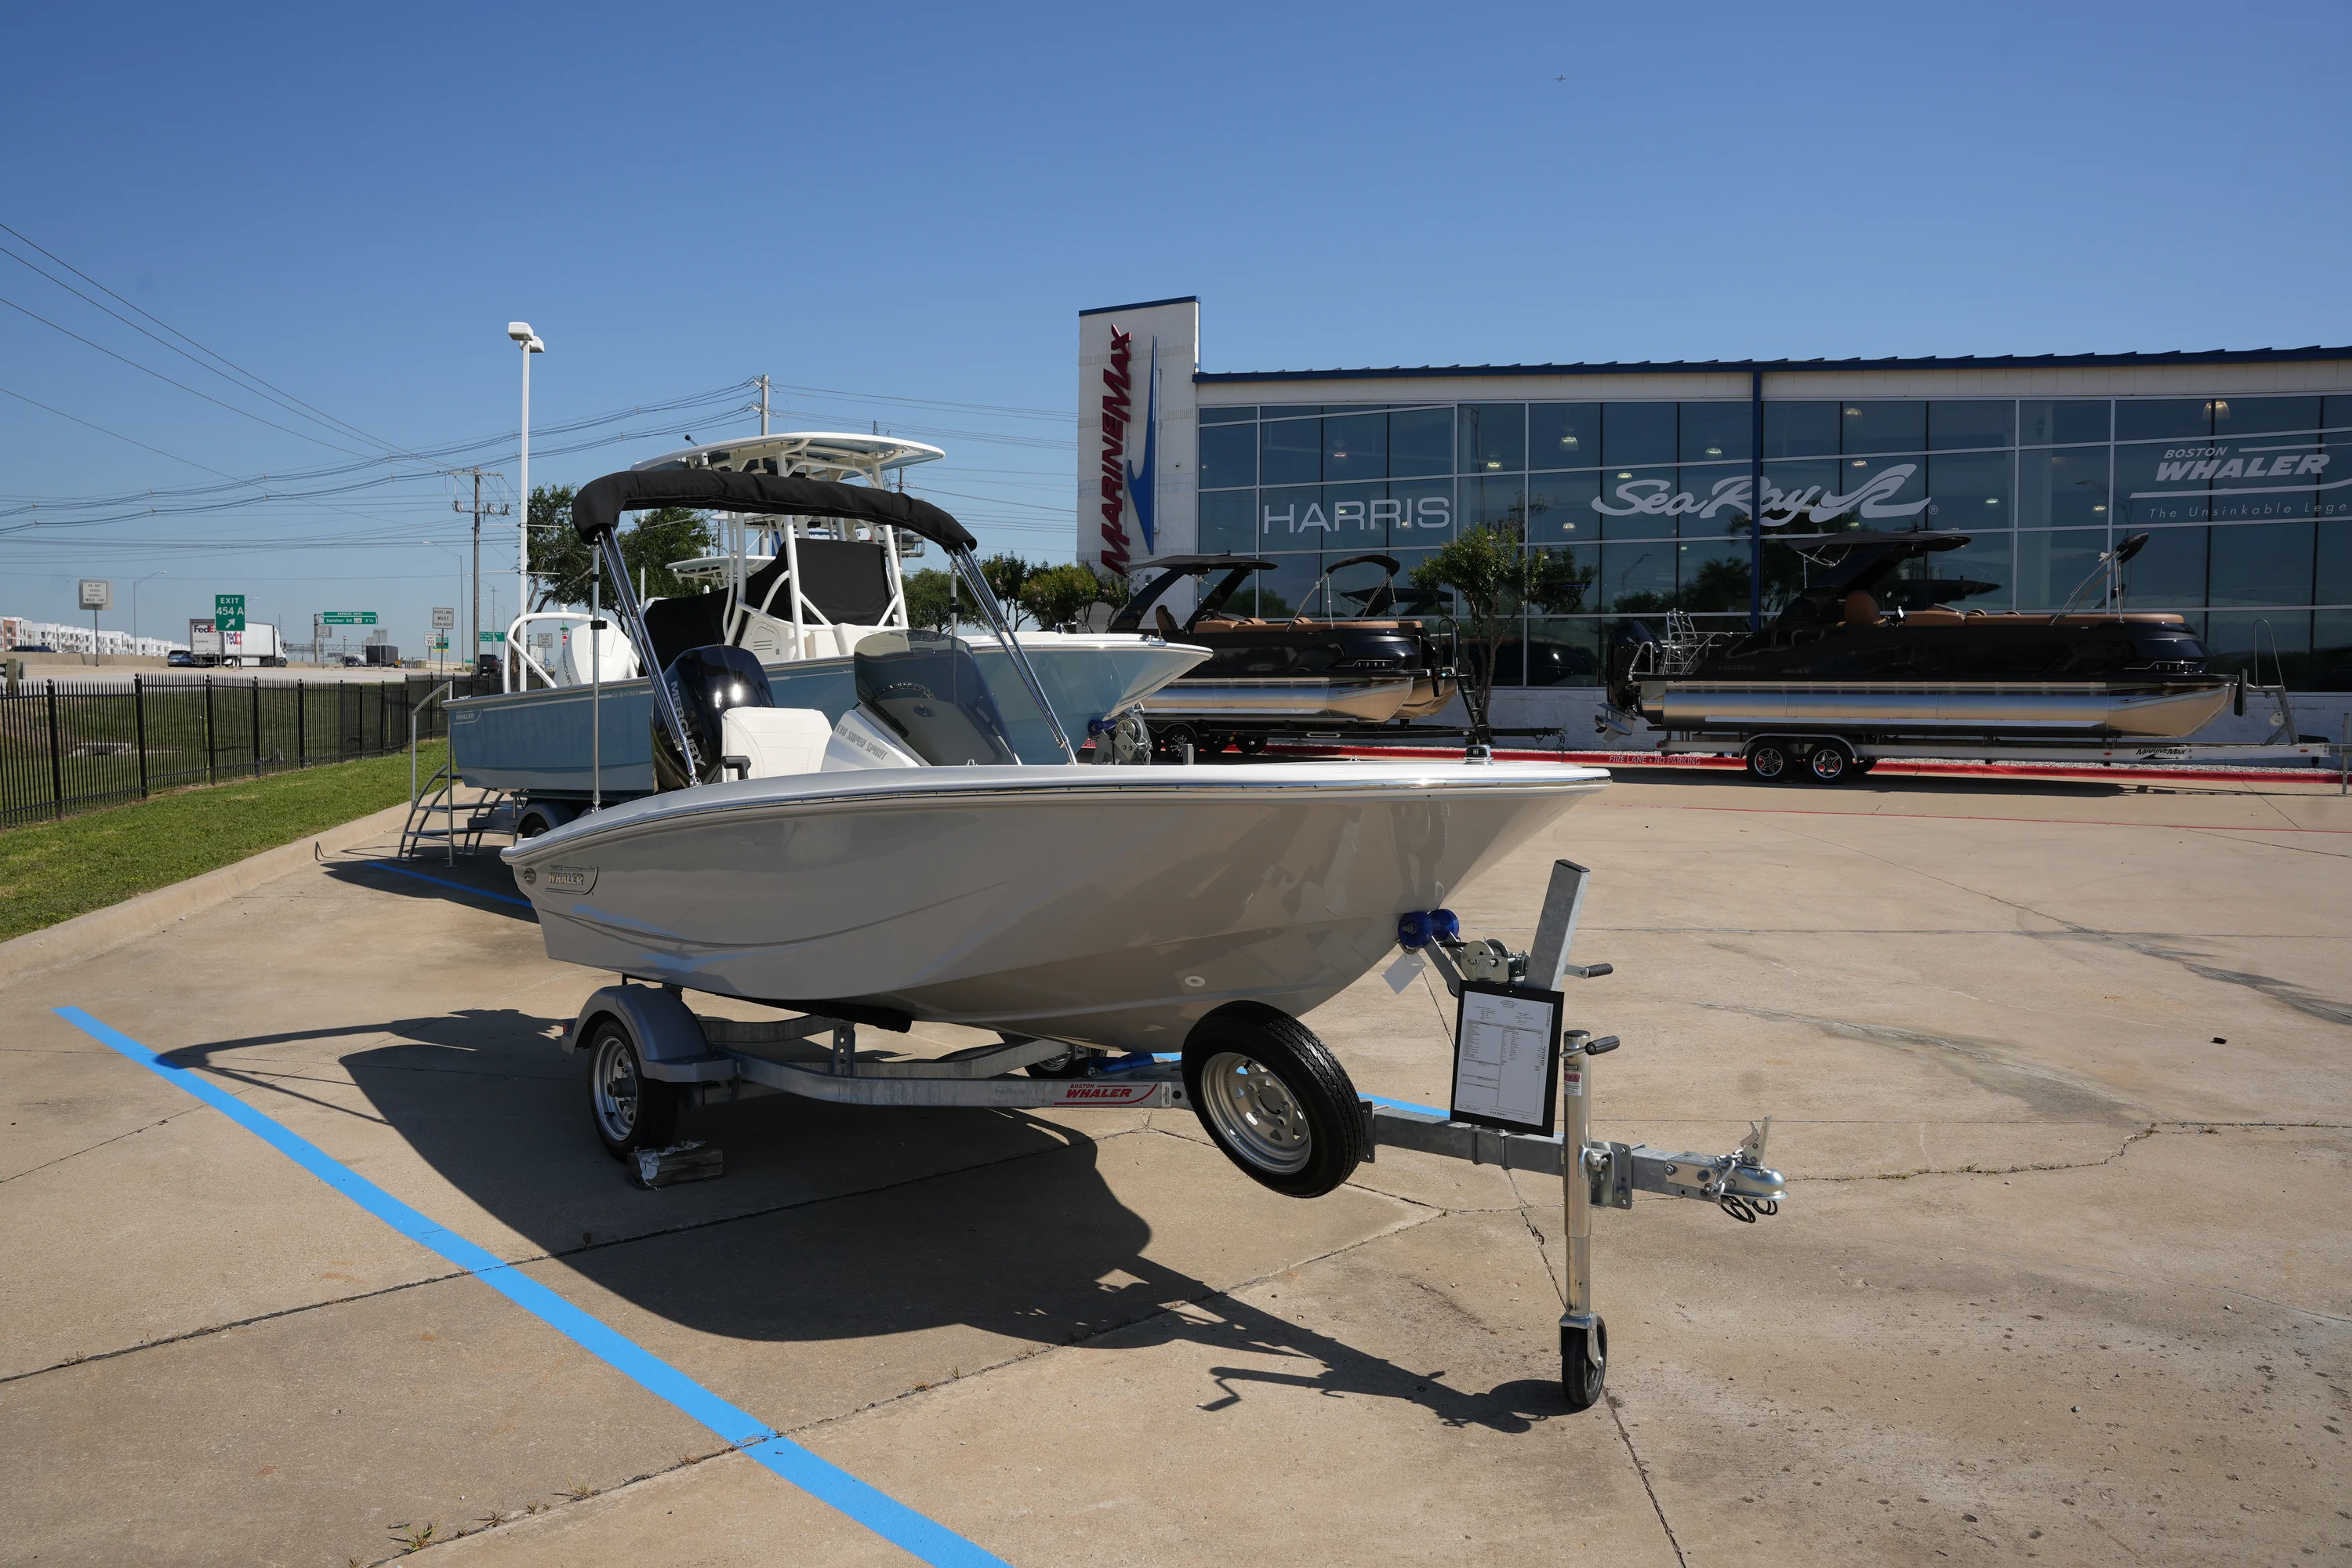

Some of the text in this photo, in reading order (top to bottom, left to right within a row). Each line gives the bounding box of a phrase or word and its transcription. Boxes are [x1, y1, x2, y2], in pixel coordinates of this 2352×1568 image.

[1102, 323, 1131, 578] MARINEMAX
[2164, 447, 2228, 459] BOSTON
[2155, 454, 2330, 481] WHALER
[1264, 497, 1450, 534] HARRIS
[1591, 475, 1822, 527] Sea Ray
[2150, 508, 2177, 518] The
[2189, 503, 2292, 517] Unsinkable
[216, 607, 244, 615] 454 A
[562, 648, 572, 686] MERCURY
[671, 681, 706, 767] MERCURY
[836, 724, 887, 760] 130 SUPER SPORT
[549, 872, 584, 885] WHALER
[1066, 1089, 1132, 1098] WHALER
